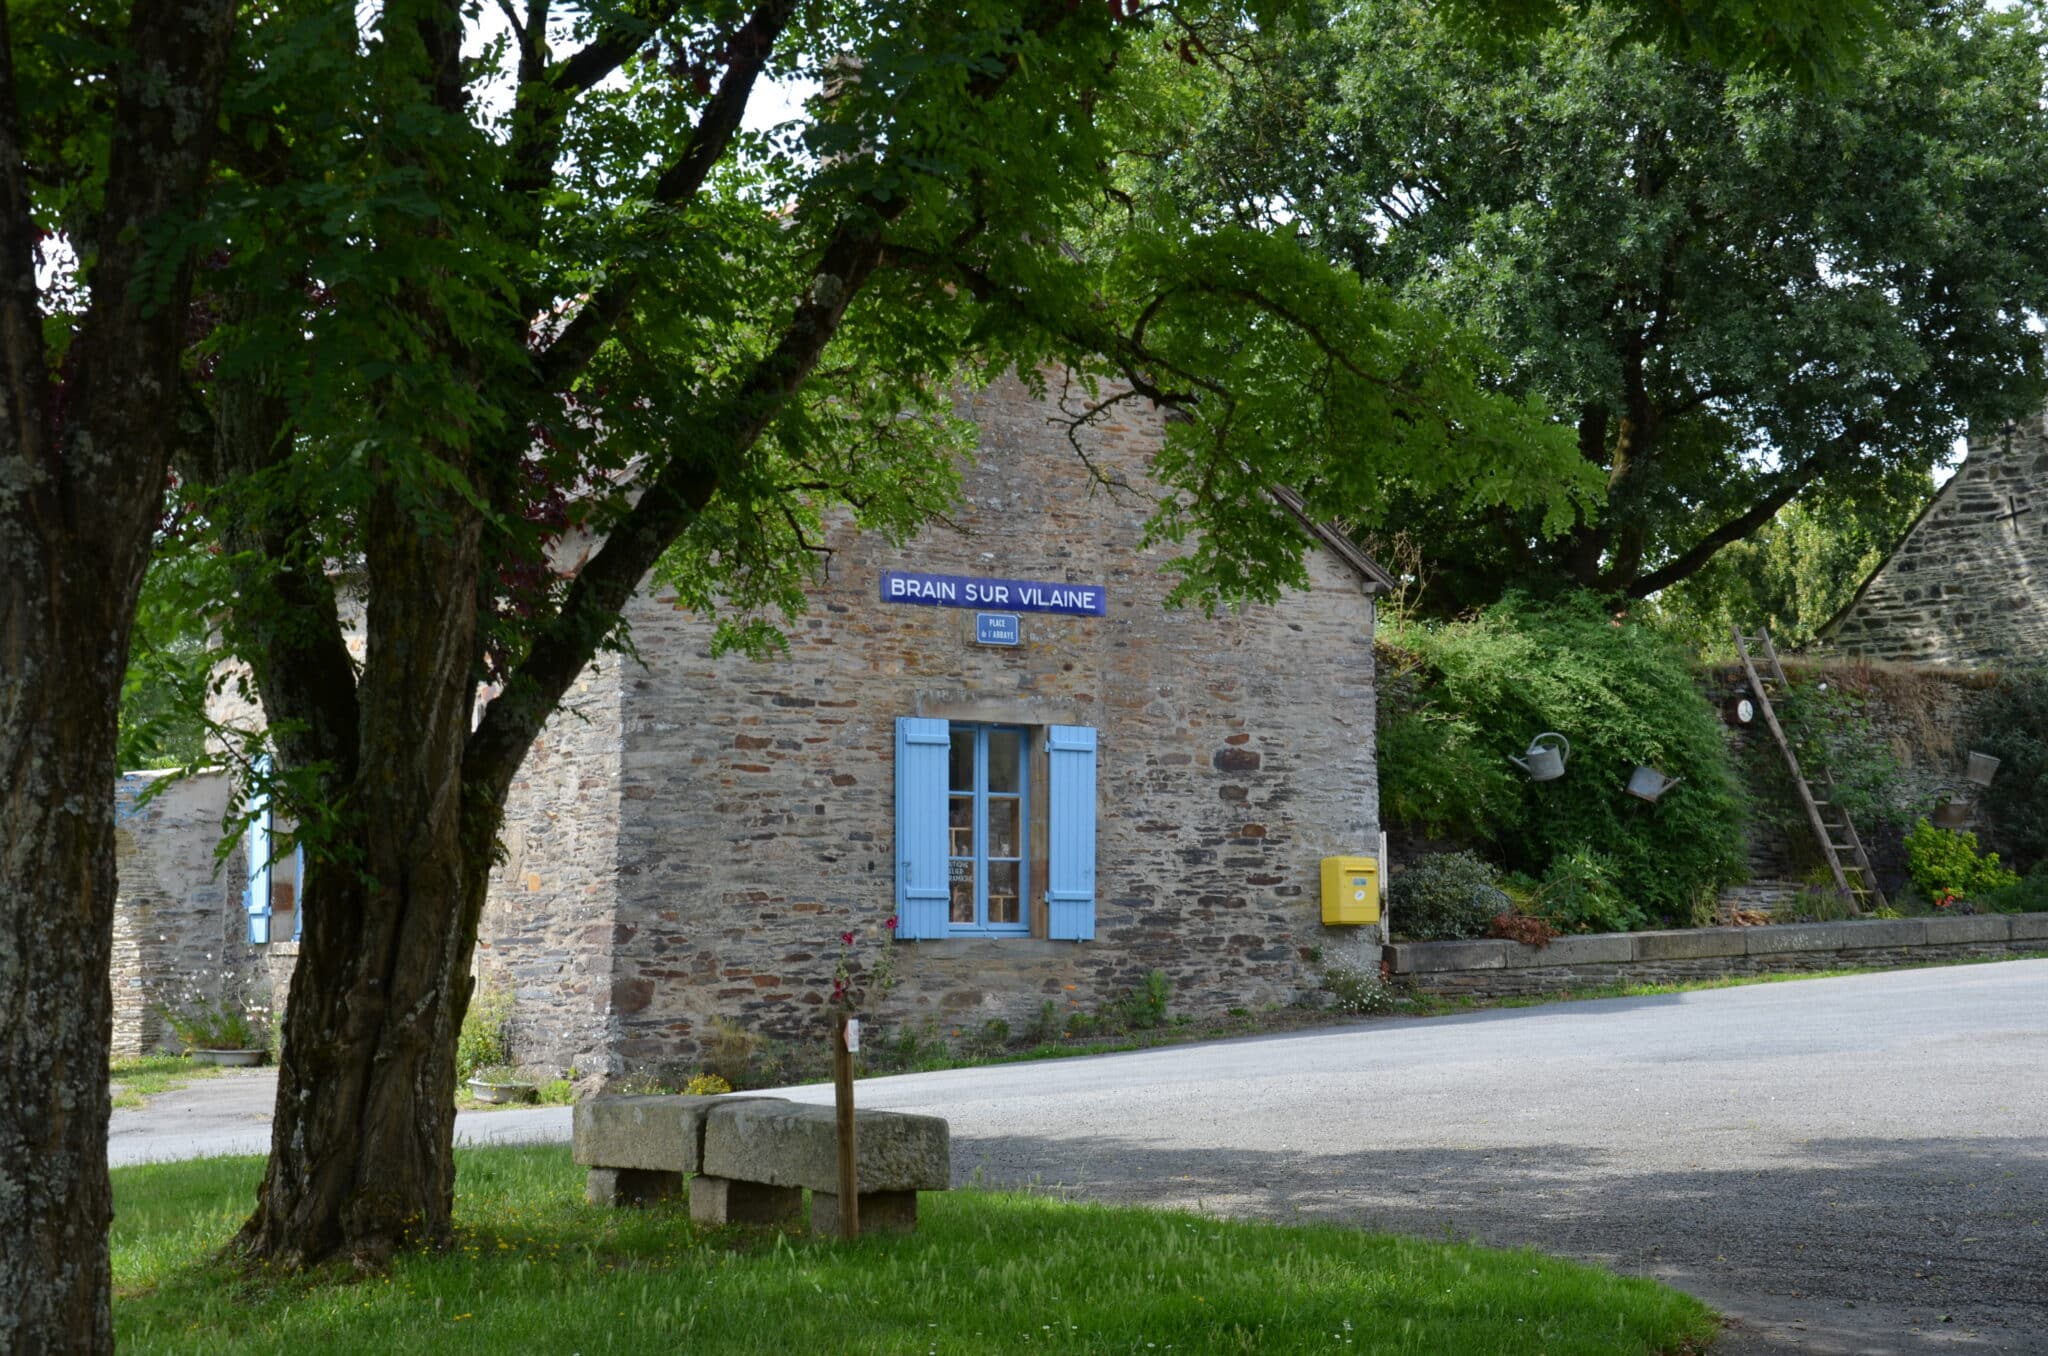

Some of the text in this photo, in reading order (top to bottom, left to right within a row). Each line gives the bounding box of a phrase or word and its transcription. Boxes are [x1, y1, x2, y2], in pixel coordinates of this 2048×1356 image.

[890, 578, 1096, 609] BRAIN SUR VILAINE
[989, 618, 1006, 628] PLACE
